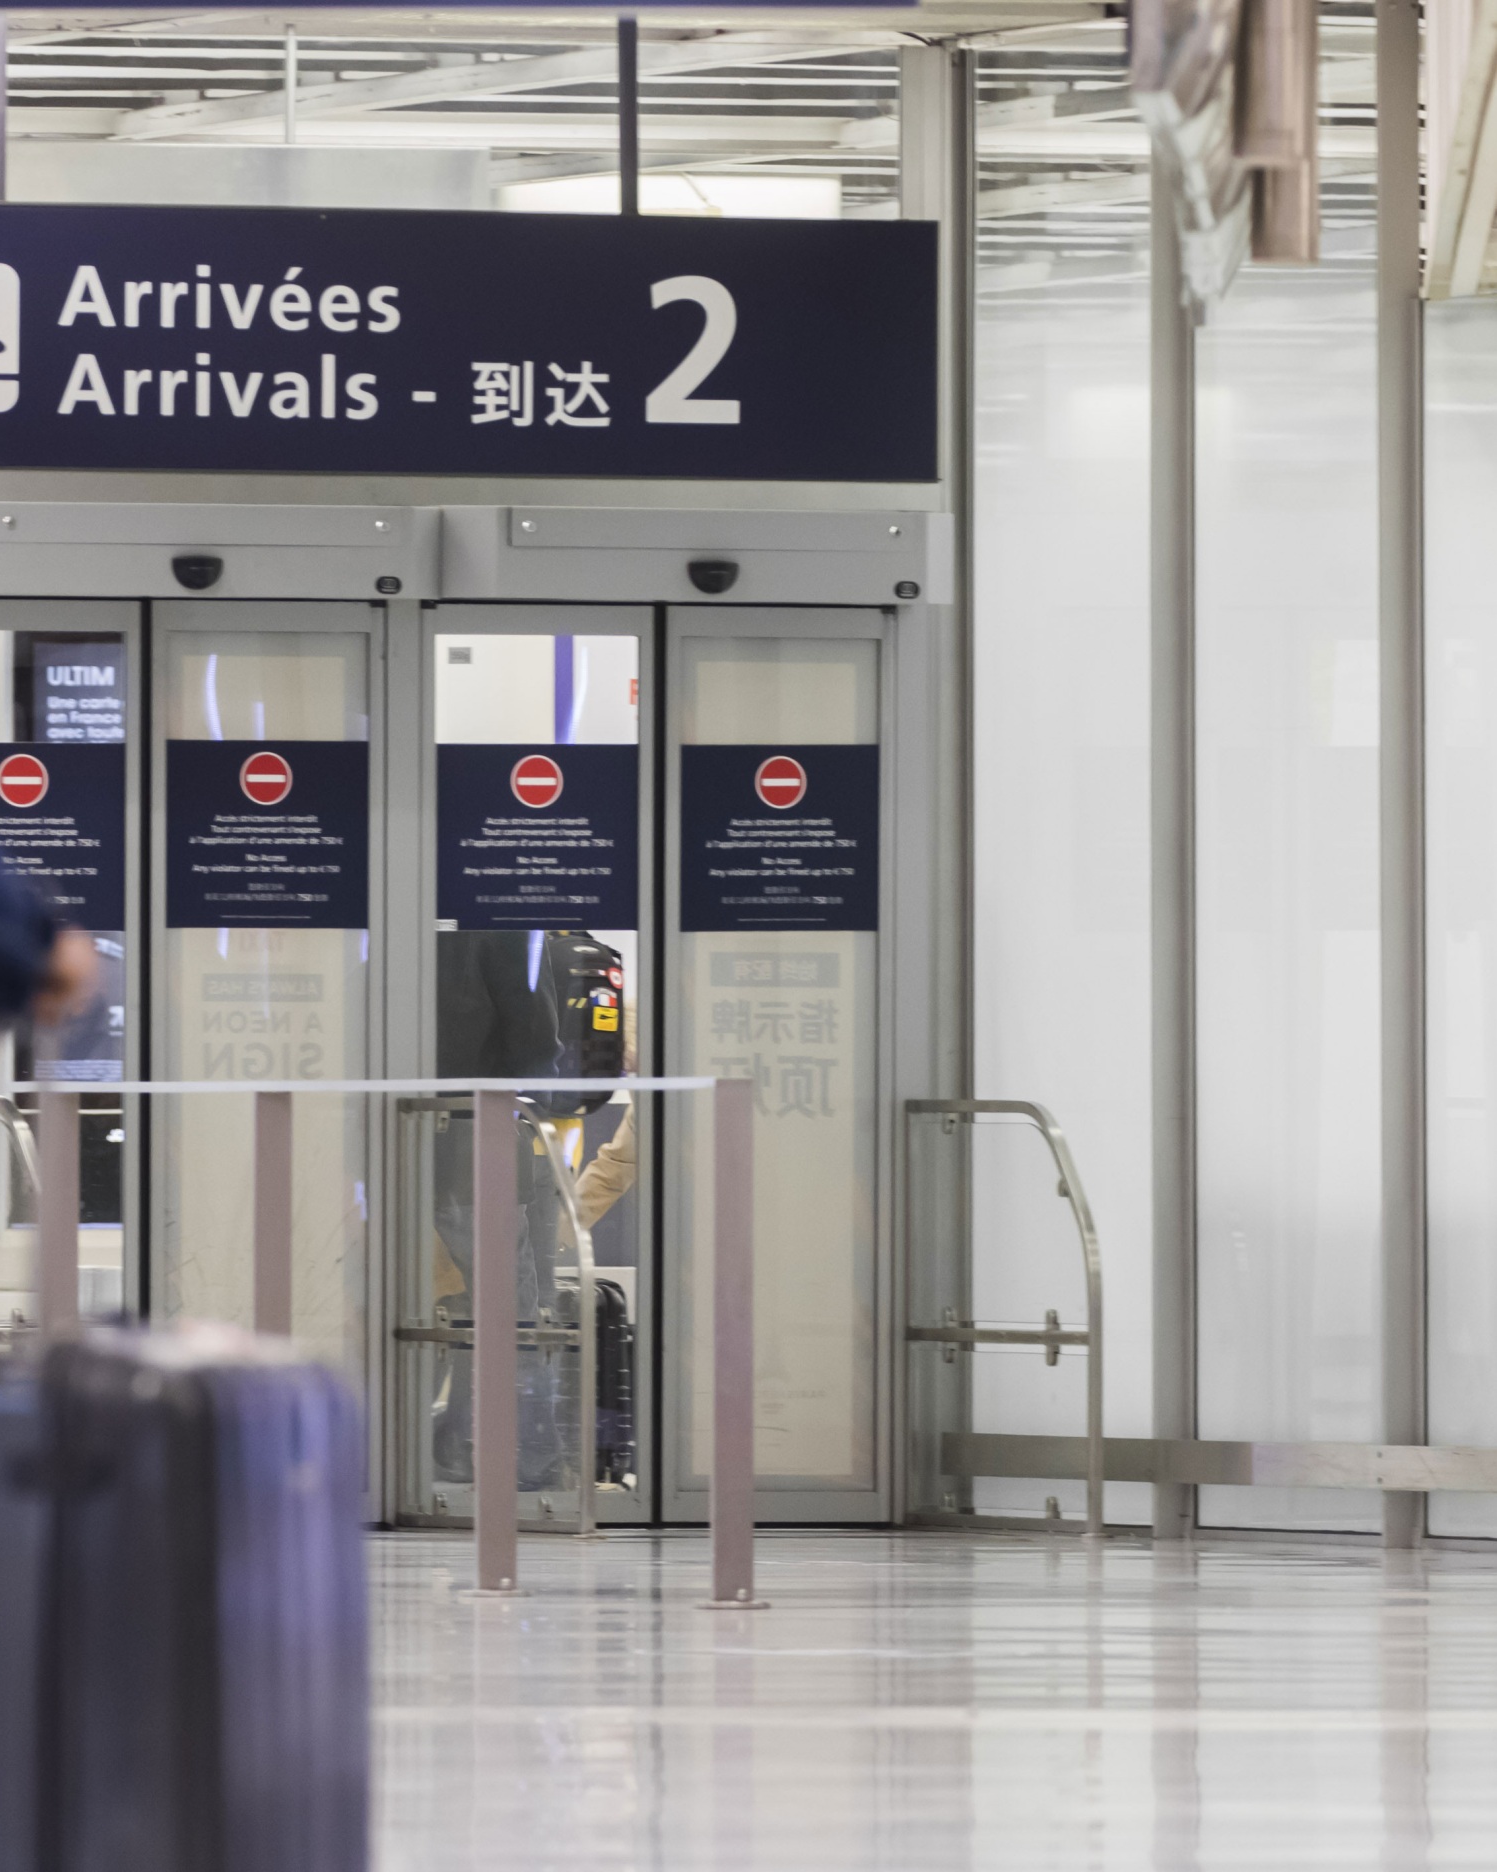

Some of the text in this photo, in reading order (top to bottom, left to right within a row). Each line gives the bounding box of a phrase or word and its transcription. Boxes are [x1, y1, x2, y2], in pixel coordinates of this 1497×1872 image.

[57, 264, 401, 333] Arrivées
[645, 275, 741, 425] 2
[57, 352, 379, 421] Arrivals
[471, 360, 611, 427] 到达
[46, 665, 116, 686] ULTIM
